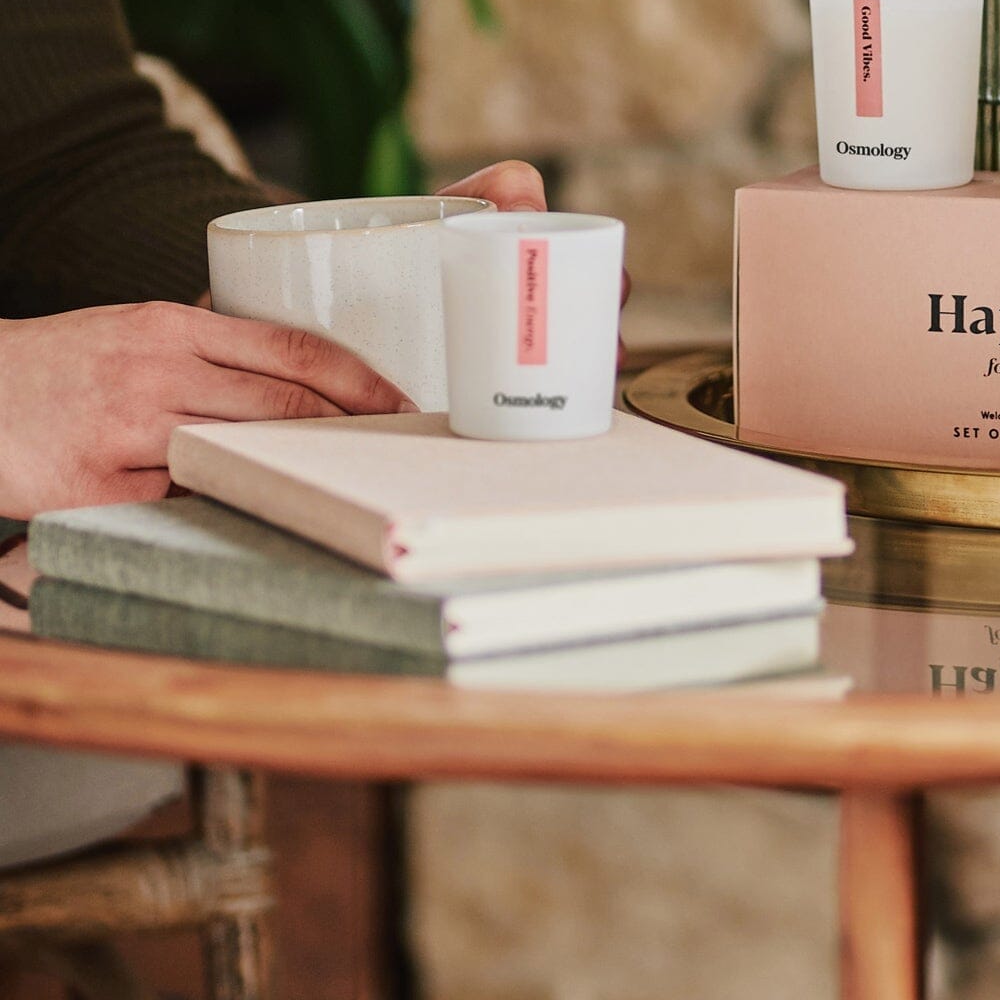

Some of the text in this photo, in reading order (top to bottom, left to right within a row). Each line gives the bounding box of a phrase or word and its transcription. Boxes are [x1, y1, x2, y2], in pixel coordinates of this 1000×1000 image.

[861, 5, 873, 82] Good Vibes.
[836, 140, 912, 160] Osmology
[953, 426, 980, 439] SET
